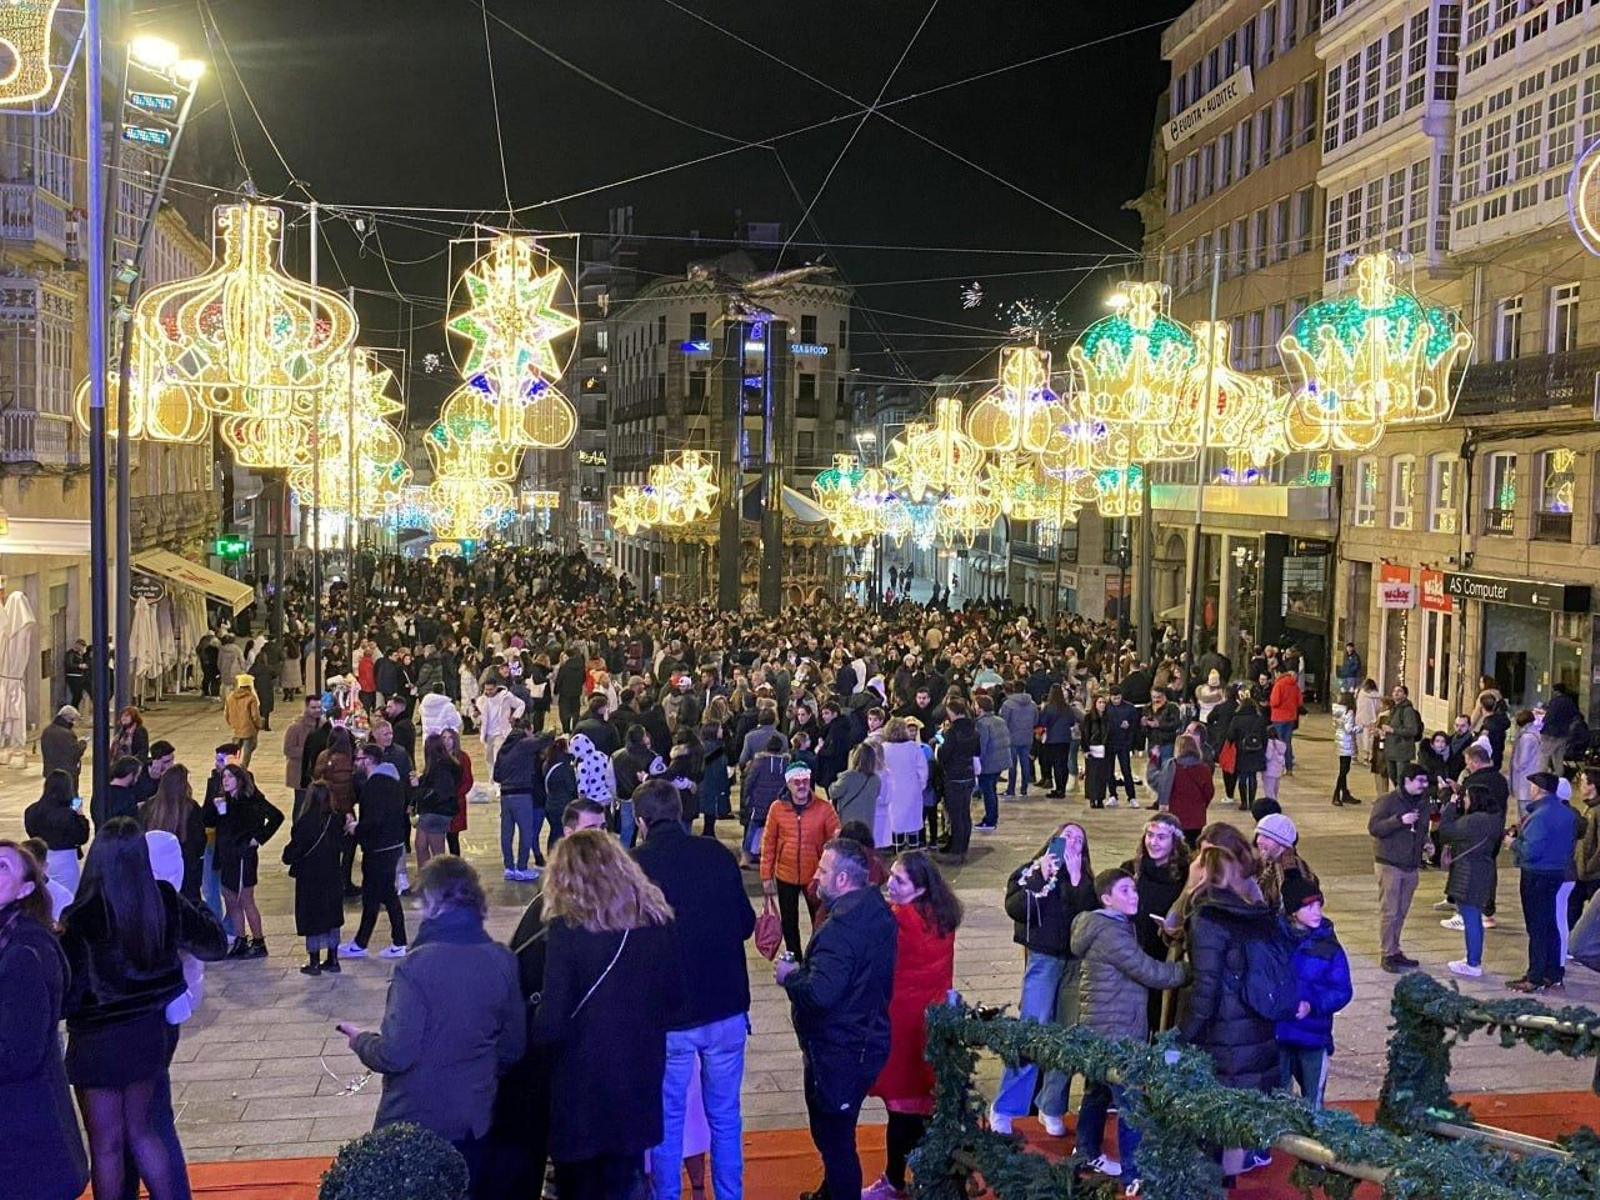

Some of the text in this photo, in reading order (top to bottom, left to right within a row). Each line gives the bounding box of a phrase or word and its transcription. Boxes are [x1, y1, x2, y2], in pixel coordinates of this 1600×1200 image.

[1179, 108, 1202, 132] EUDITA
[1207, 82, 1237, 112] AUDITEC
[1449, 578, 1462, 593] AS
[1463, 579, 1508, 600] Computer
